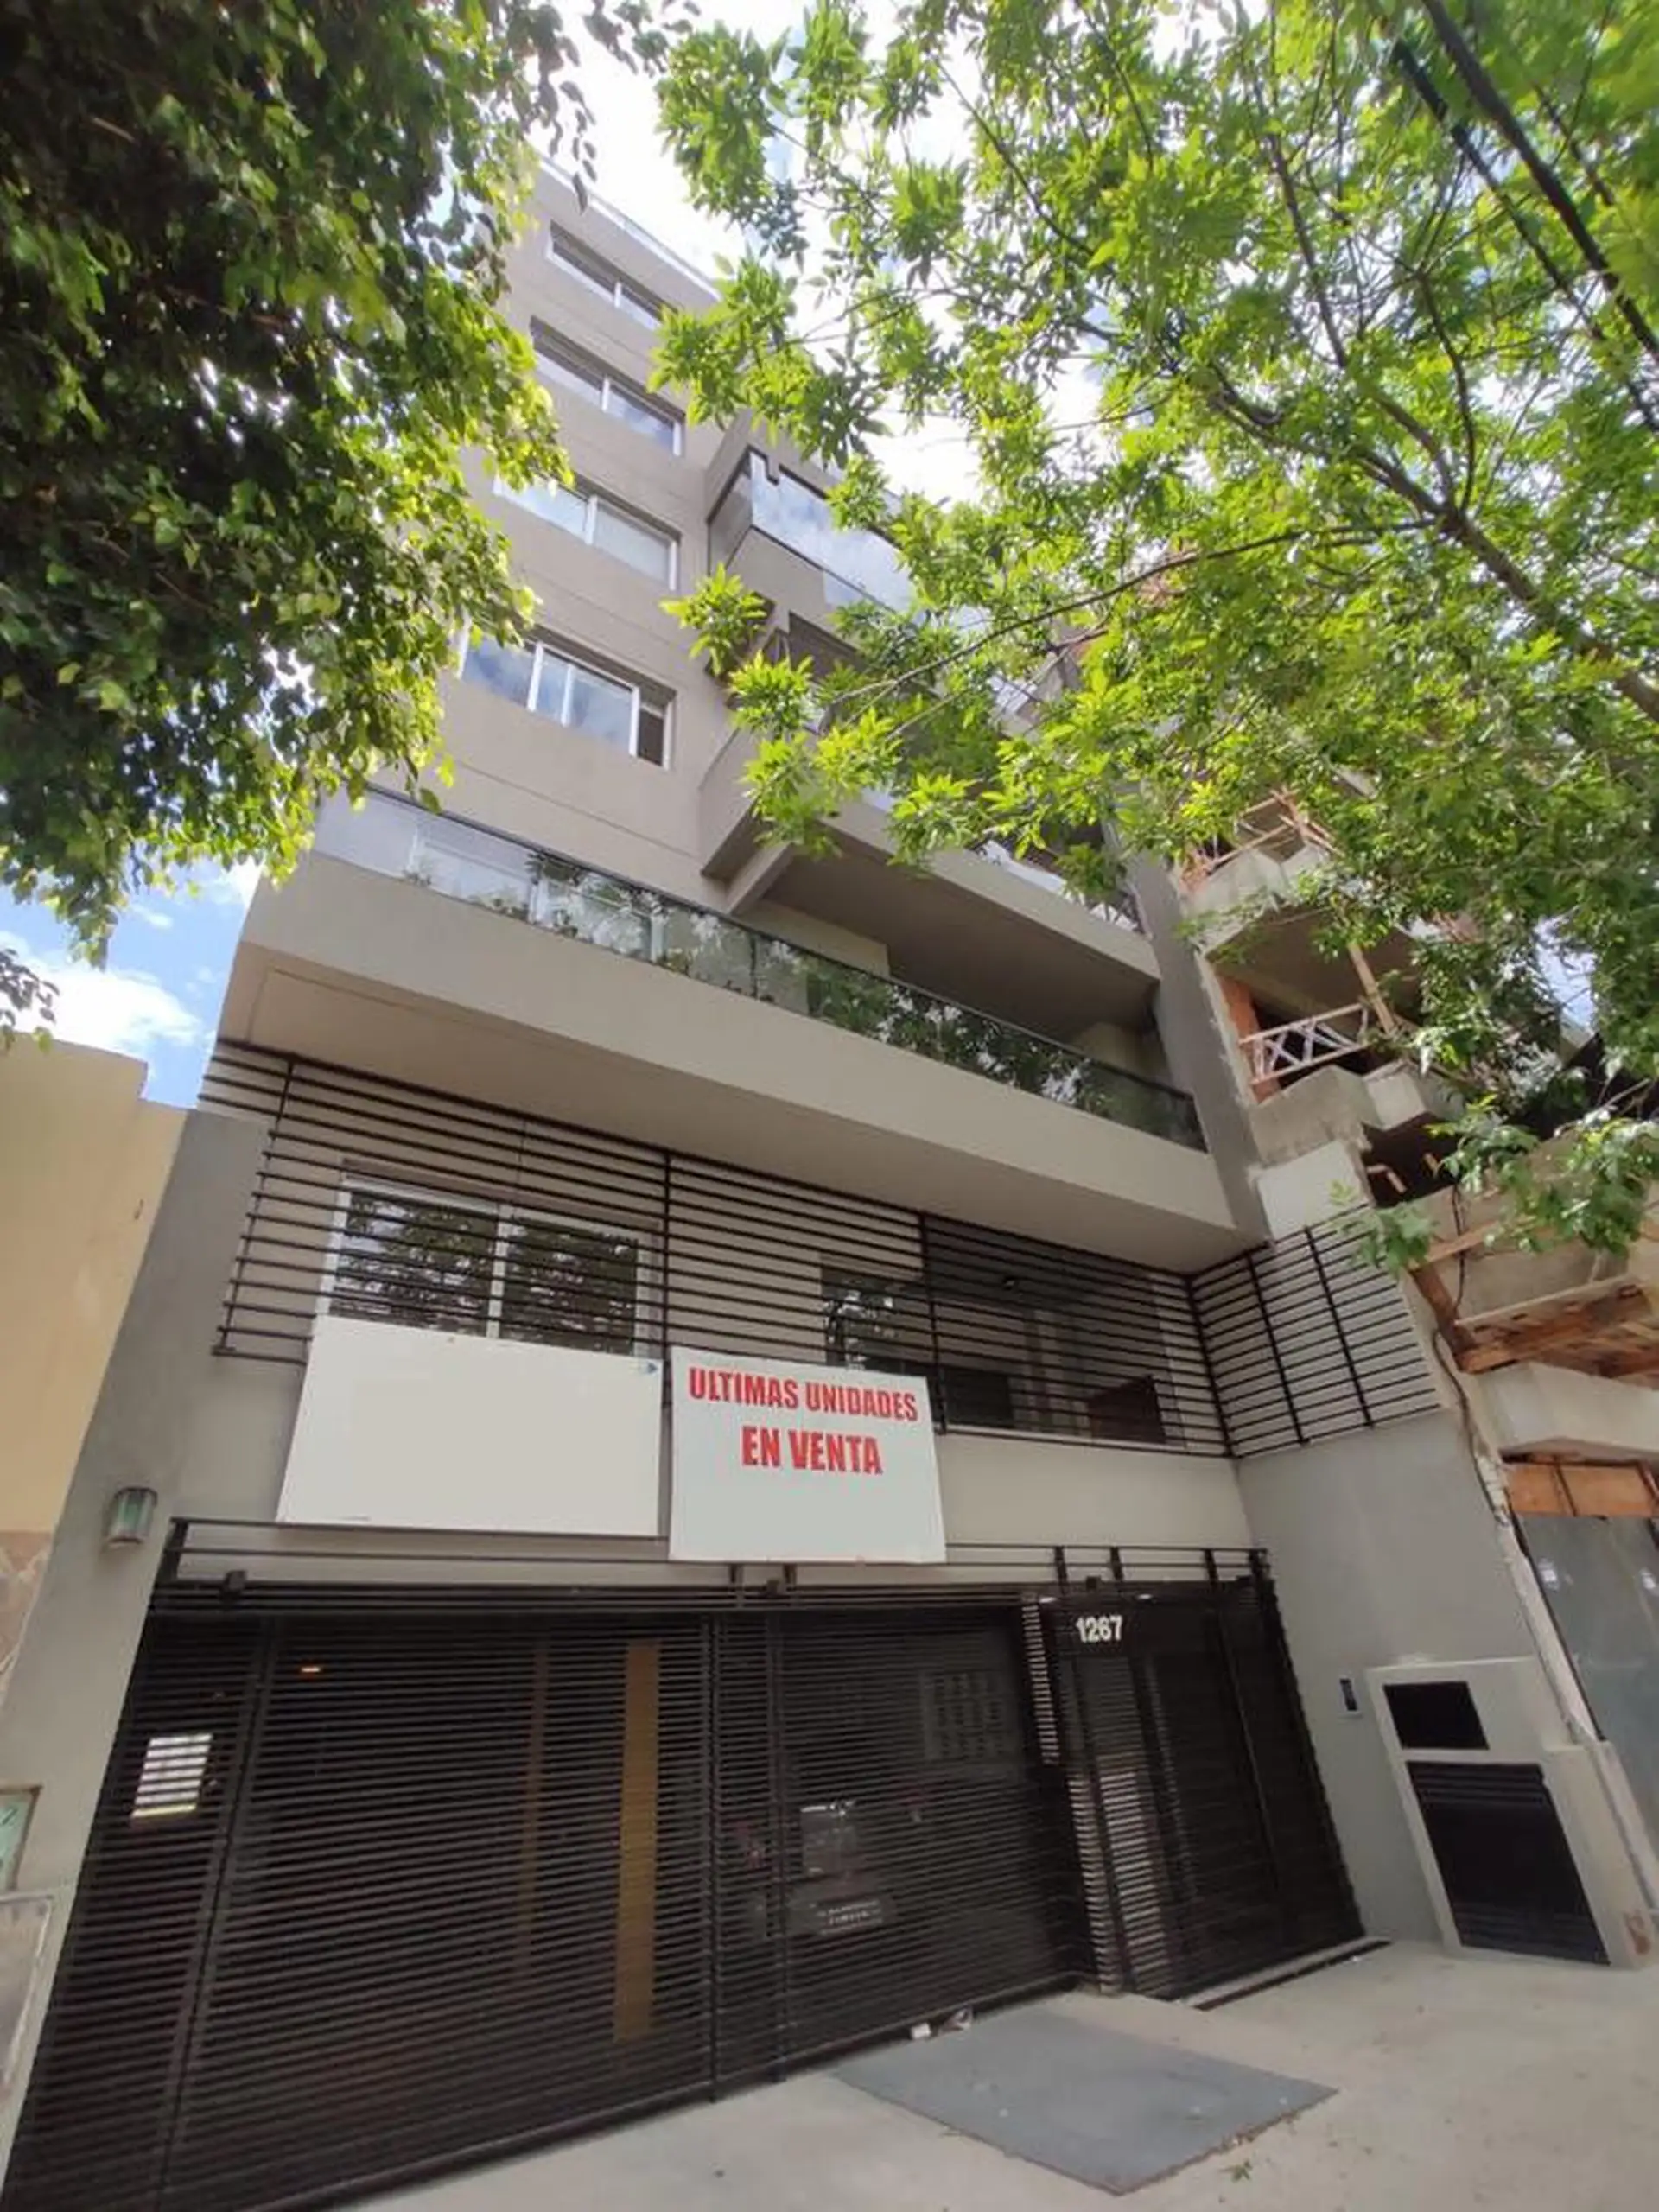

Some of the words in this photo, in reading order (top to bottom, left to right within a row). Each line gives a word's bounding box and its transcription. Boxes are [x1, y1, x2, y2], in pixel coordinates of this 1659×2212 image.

[689, 1368, 798, 1409] ULTIMAS
[805, 1382, 918, 1421] UNIDADES
[741, 1426, 780, 1466] EN
[788, 1430, 882, 1474] VENTA
[1075, 1615, 1123, 1643] 1267
